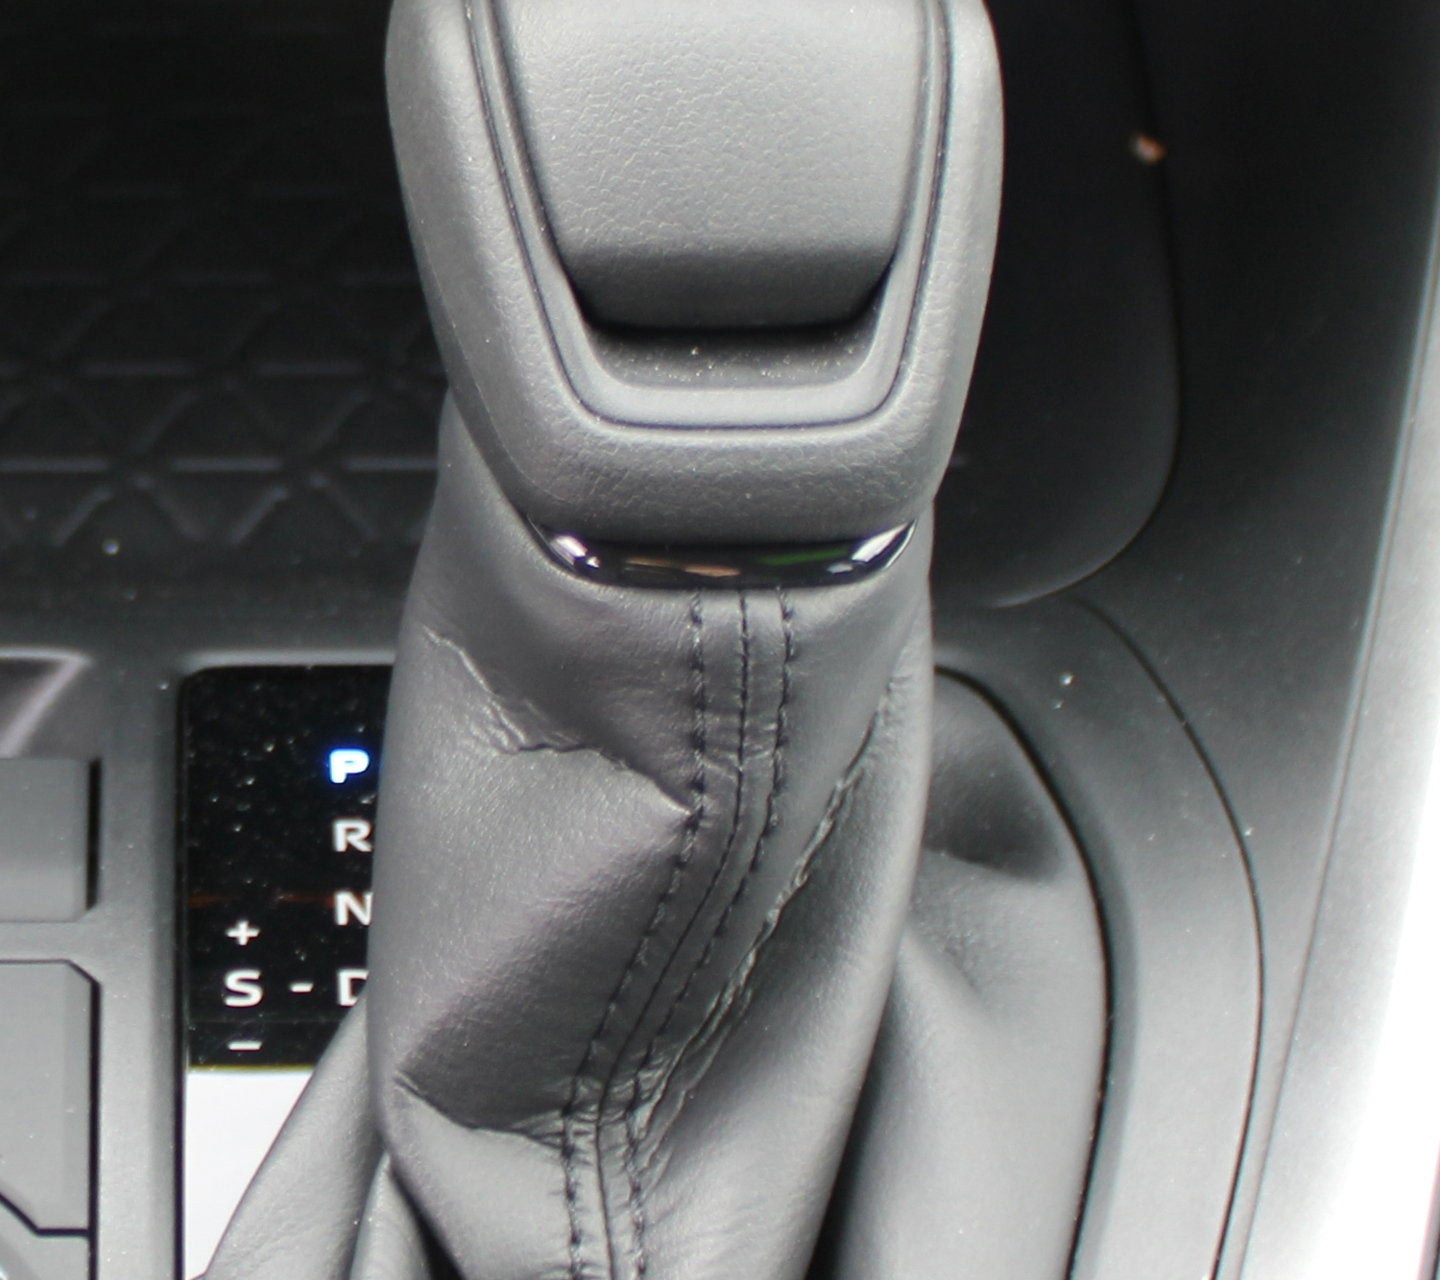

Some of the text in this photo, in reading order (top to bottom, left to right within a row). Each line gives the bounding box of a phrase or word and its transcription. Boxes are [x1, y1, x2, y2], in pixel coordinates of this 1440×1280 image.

[329, 749, 370, 783] P
[332, 821, 372, 852] R
[334, 892, 372, 925] N
[224, 969, 263, 1007] S
